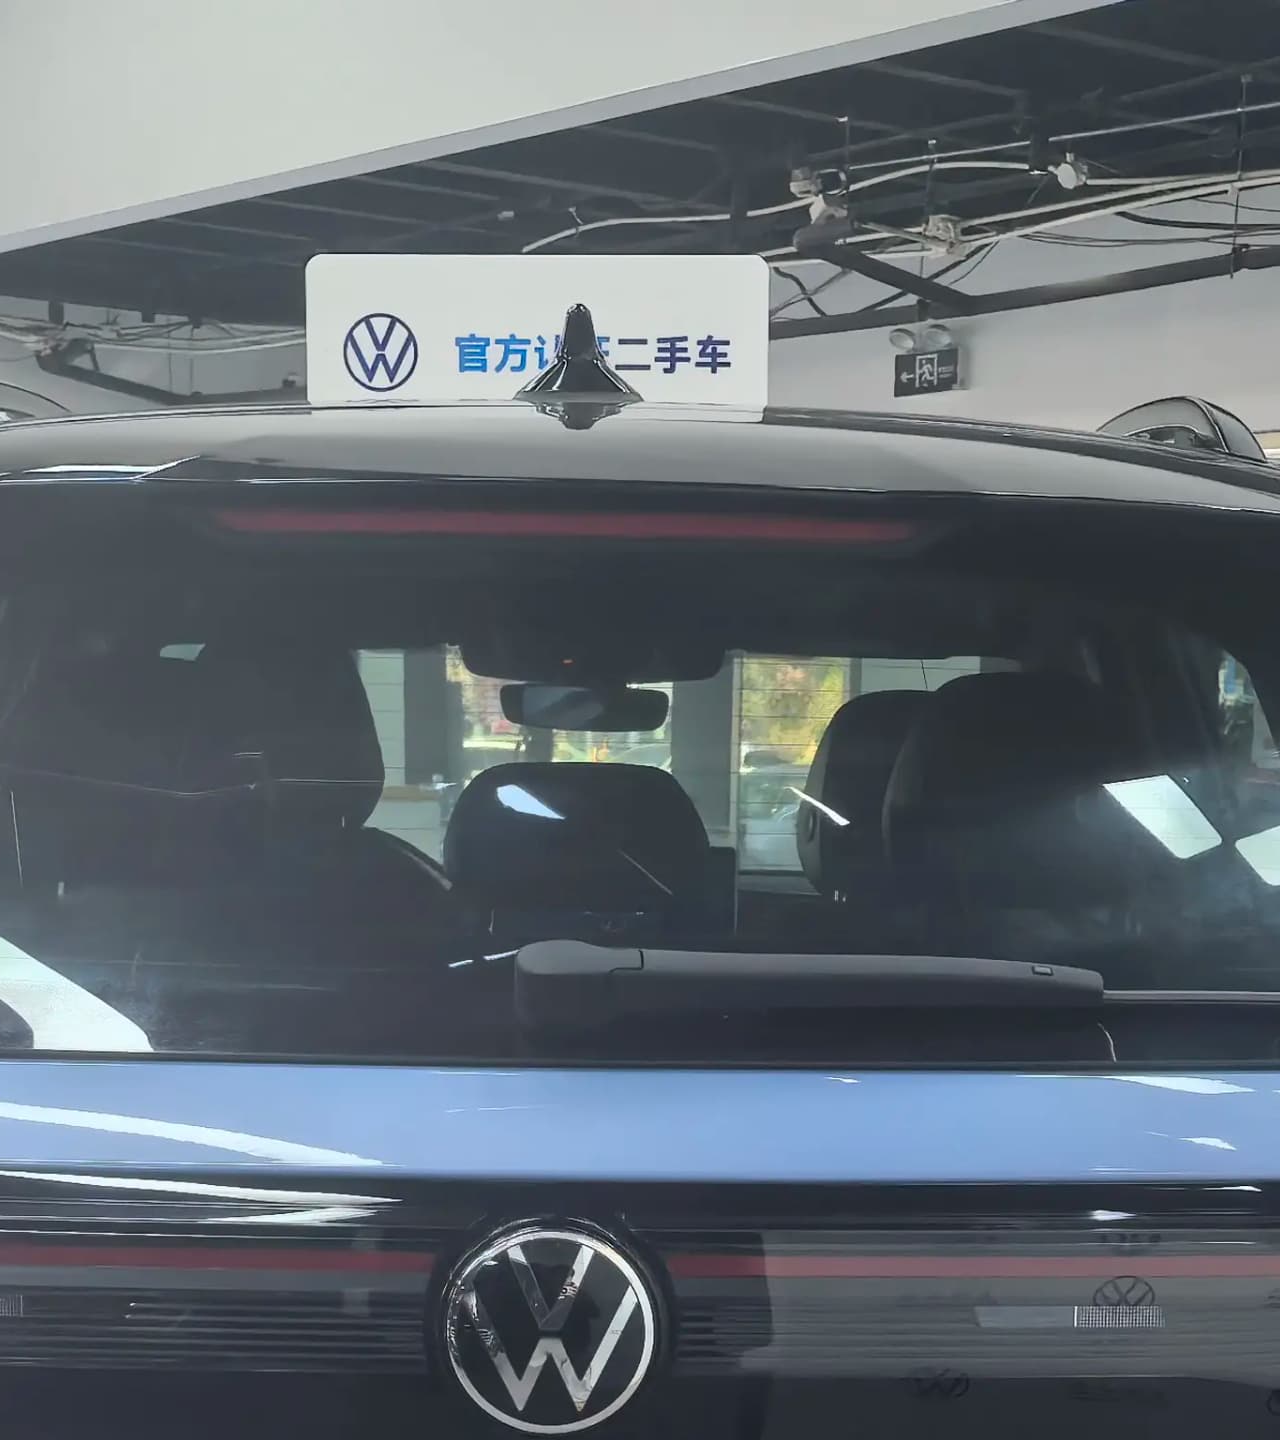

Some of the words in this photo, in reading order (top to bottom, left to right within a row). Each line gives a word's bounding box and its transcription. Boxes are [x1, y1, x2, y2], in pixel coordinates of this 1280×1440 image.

[454, 333, 732, 374] 官方认二手车
